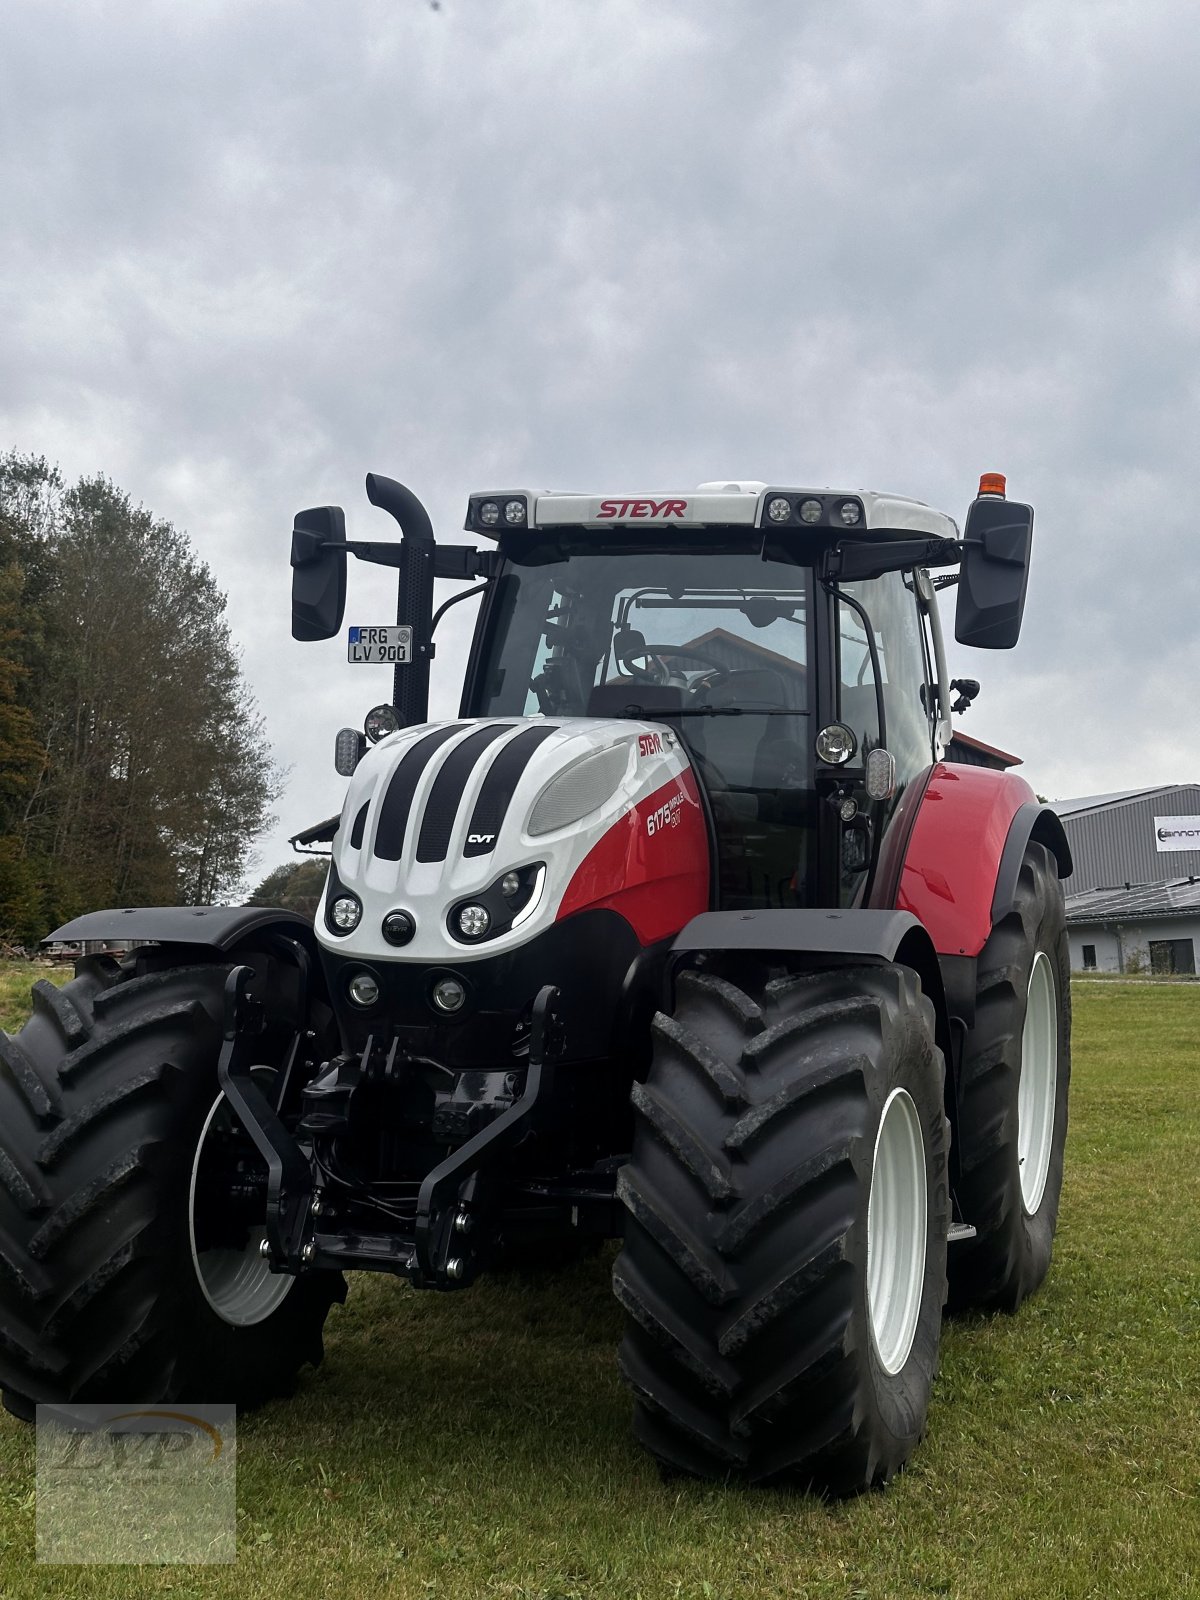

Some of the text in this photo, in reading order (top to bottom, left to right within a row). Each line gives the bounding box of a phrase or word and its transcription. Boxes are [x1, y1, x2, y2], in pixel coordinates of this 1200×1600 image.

[596, 499, 688, 518] STEYR
[360, 628, 388, 644] FRG
[353, 645, 406, 661] LV 900
[638, 733, 664, 757] STEYR
[647, 803, 671, 837] 6175
[468, 834, 495, 843] CVT
